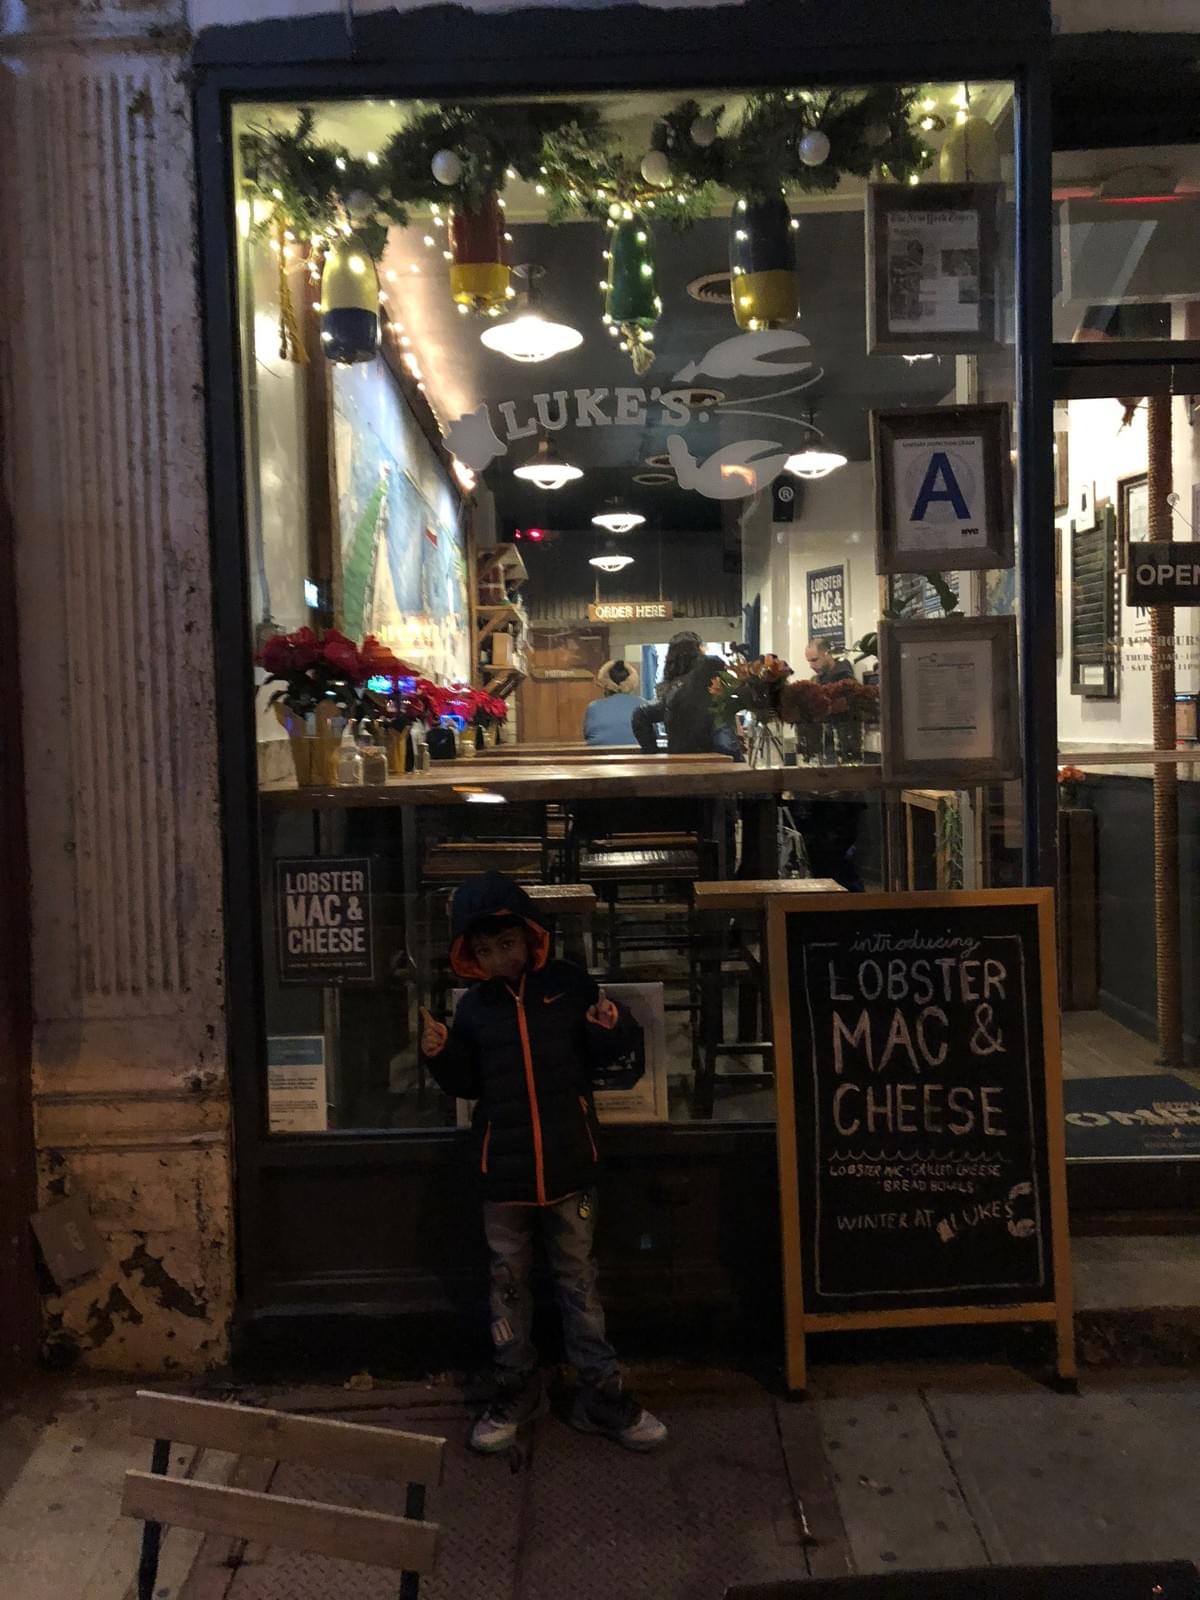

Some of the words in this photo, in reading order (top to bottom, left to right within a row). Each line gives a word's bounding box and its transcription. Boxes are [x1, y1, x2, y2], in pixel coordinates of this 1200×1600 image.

[498, 386, 691, 441] LUKE'S
[910, 452, 971, 521] A
[811, 575, 843, 593] LOBSTER
[595, 605, 634, 618] ORDER
[636, 604, 666, 617] HERE
[812, 591, 833, 613] MAC
[834, 590, 842, 606] &
[812, 610, 843, 629] CHEESE
[286, 871, 364, 894] LOBSTER
[287, 894, 341, 928] MAC
[347, 895, 364, 921] &
[287, 927, 366, 954] CHEESE
[850, 929, 982, 957] introducing
[828, 958, 1008, 1005] LOBSTER
[832, 1005, 950, 1074] MAC
[970, 1002, 1008, 1056] &
[832, 1082, 1008, 1137] CHEESE
[836, 1212, 910, 1231] WINTER
[913, 1208, 936, 1228] AT
